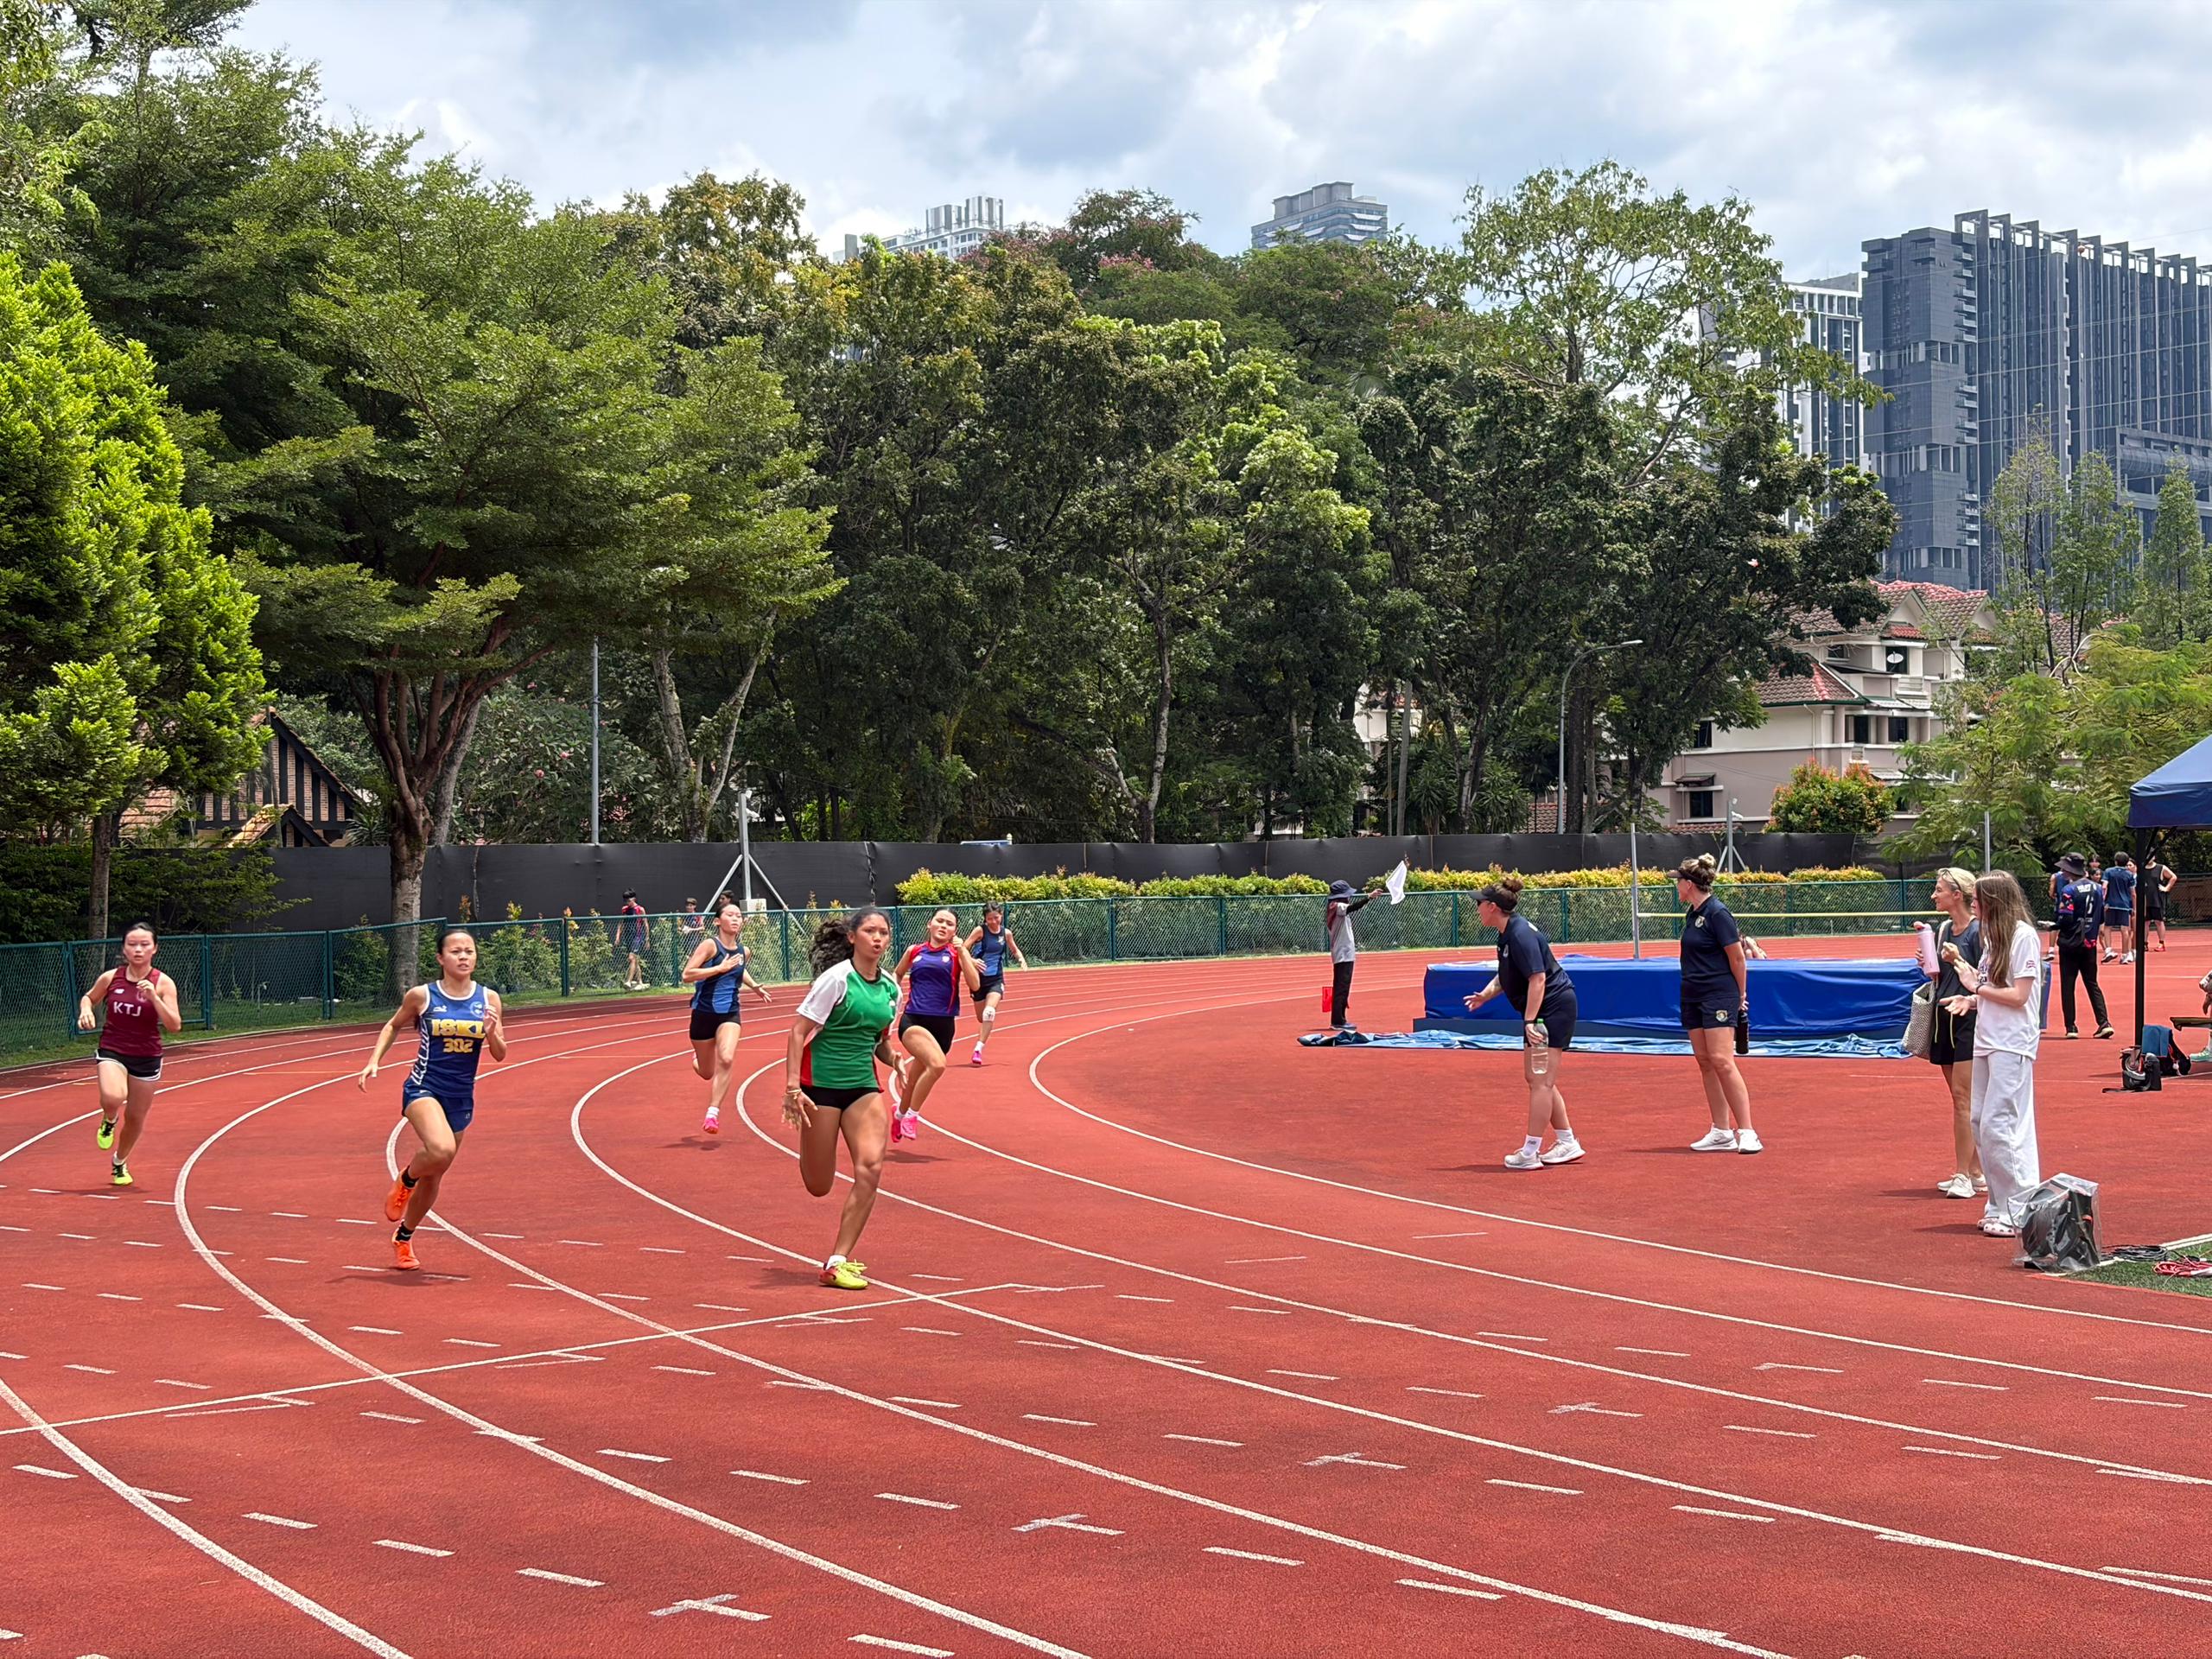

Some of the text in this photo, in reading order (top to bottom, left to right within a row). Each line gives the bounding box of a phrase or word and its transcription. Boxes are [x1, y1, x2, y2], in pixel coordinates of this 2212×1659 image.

[113, 1001, 142, 1016] KTJ
[432, 1019, 486, 1039] ISKL
[443, 1038, 474, 1052] 302
